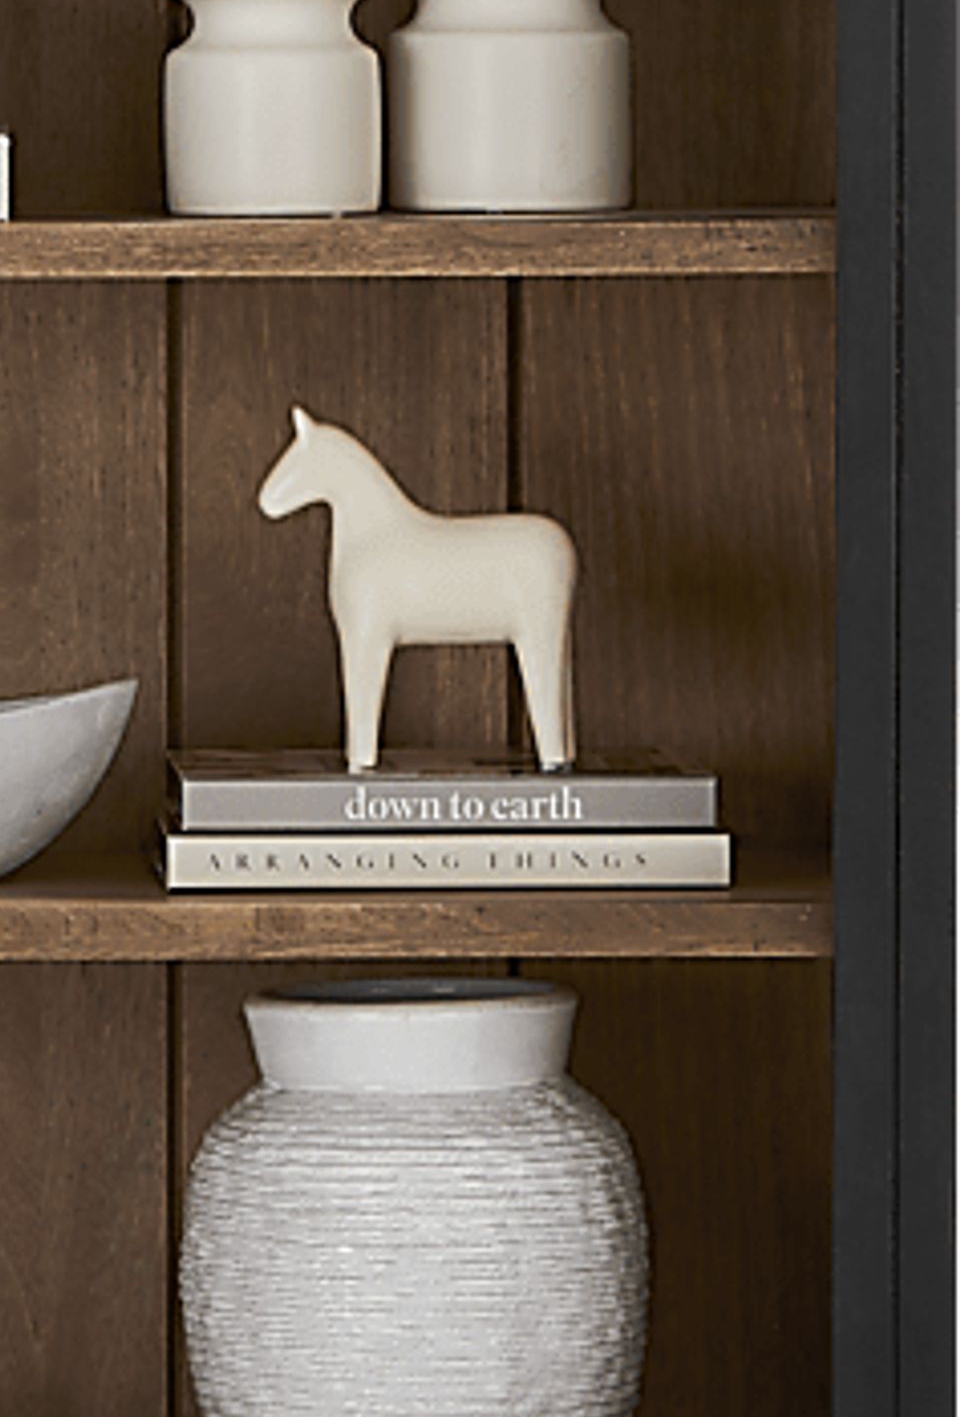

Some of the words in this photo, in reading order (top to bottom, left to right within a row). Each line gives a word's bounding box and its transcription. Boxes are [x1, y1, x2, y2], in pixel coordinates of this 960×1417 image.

[344, 786, 440, 821] down
[448, 791, 484, 821] to
[490, 786, 584, 821] earth
[207, 850, 462, 873] ARRANGING
[488, 849, 649, 871] THINGS
